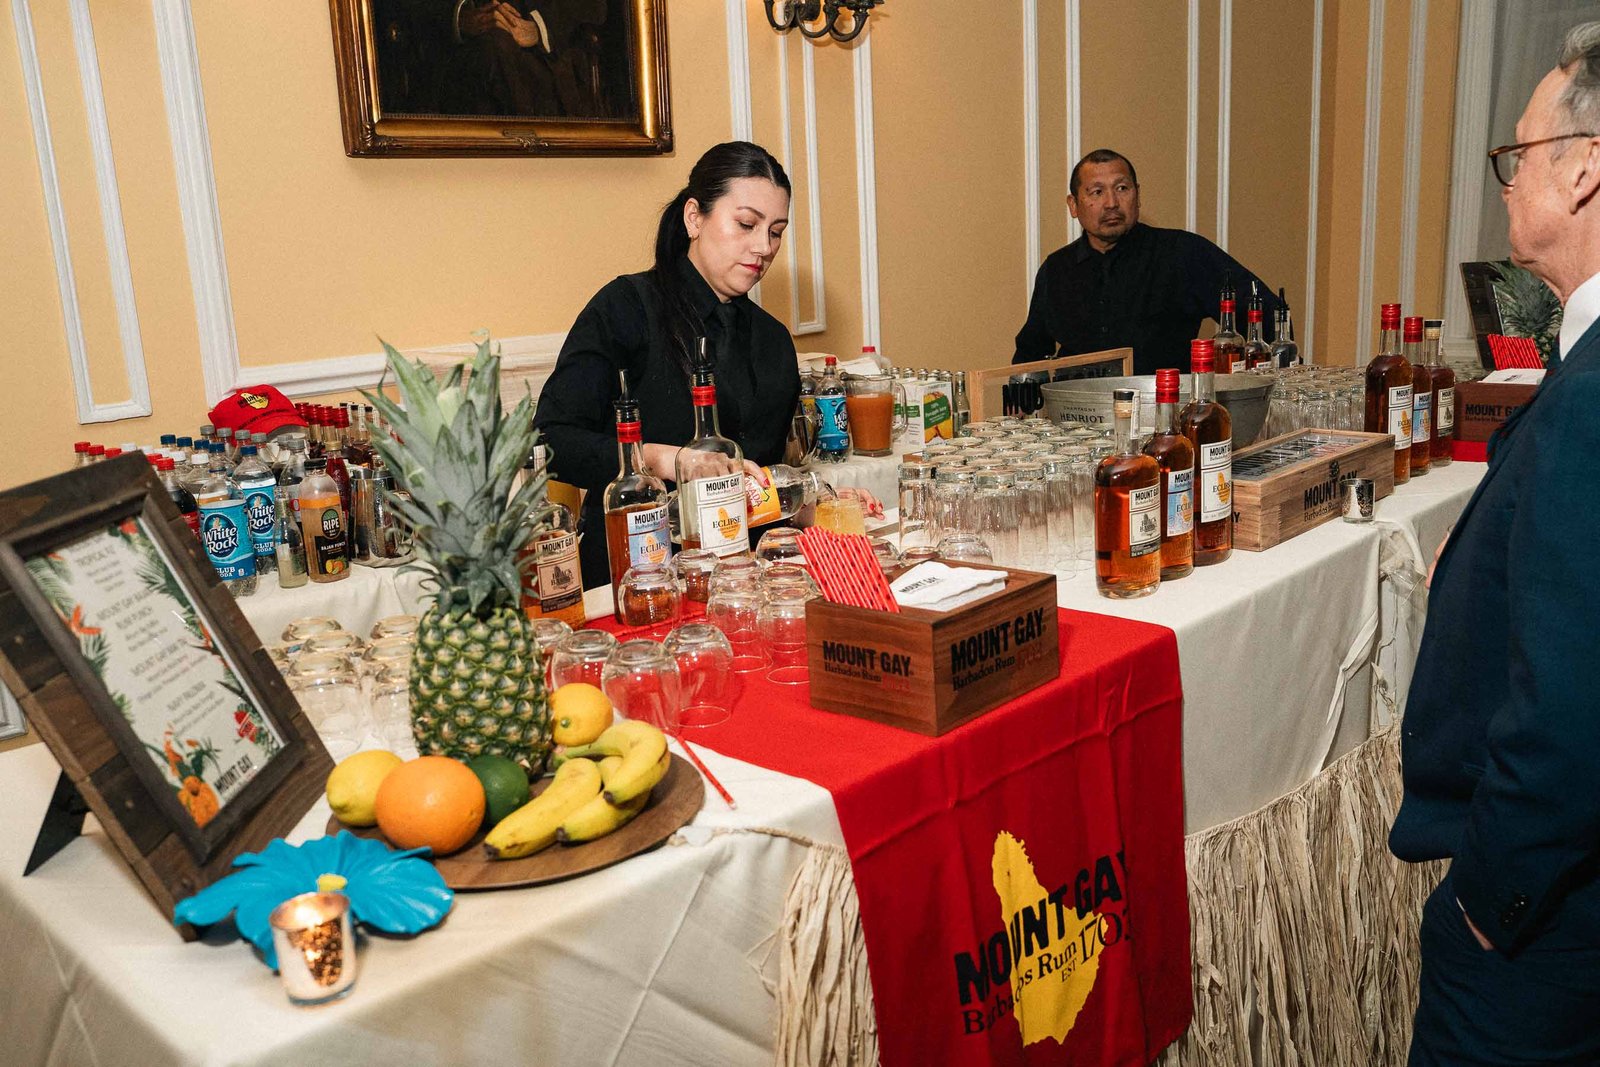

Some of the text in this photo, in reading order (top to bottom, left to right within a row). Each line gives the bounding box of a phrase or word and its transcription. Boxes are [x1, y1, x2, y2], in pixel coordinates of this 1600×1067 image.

[1060, 413, 1105, 424] HENRIOT
[1466, 404, 1502, 416] MOUNT
[706, 477, 740, 492] MOUNT GAY
[1135, 489, 1153, 501] MOUNT
[1304, 479, 1338, 511] MOUNT
[322, 518, 340, 531] RIPE
[634, 511, 659, 524] MOUNT
[712, 515, 742, 529] ECLIPSE
[203, 527, 237, 546] White
[207, 537, 238, 554] Rock
[542, 540, 565, 553] MOUNT
[951, 621, 1011, 675] MOUNT
[1014, 607, 1044, 646] GAY
[822, 640, 911, 678] MOUNT GAY
[824, 661, 861, 678] Barbados
[862, 669, 882, 683] Rum
[952, 664, 995, 692] Barbados
[994, 655, 1016, 673] Rum
[212, 764, 242, 795] MOUNT
[235, 753, 254, 774] GAY
[1037, 940, 1078, 980] Rum
[1079, 908, 1131, 965] 170
